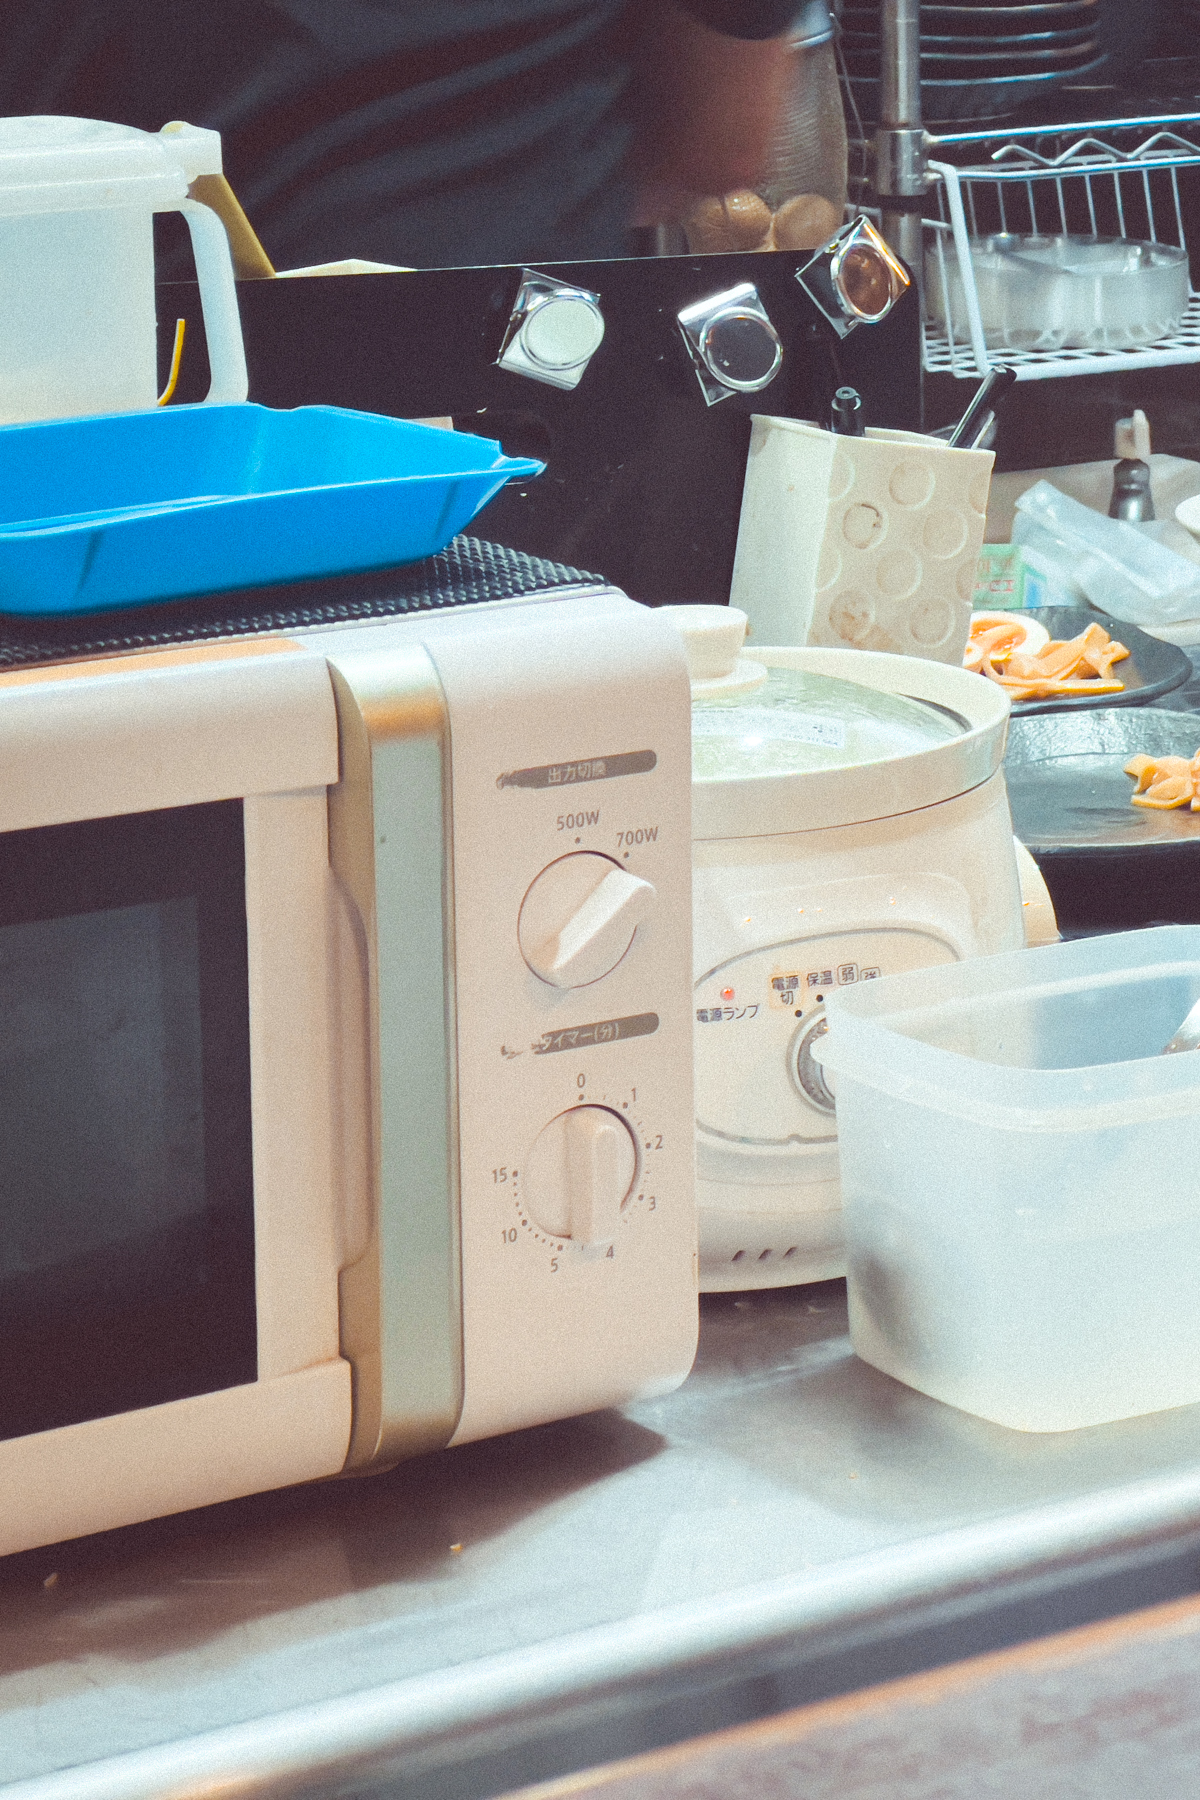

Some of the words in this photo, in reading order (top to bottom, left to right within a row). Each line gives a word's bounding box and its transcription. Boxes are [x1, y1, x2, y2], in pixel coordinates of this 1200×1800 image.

[548, 759, 607, 784] 出力切換
[556, 809, 601, 831] 500W
[616, 826, 660, 848] 700W
[771, 974, 799, 991] 電源
[806, 970, 834, 987] 保温
[841, 966, 855, 982] 弱
[780, 990, 794, 1005] 切
[696, 1003, 760, 1023] 電源ランプ
[576, 1073, 586, 1089] 0
[631, 1087, 637, 1102] 1
[655, 1135, 664, 1150] 2
[492, 1167, 508, 1184] 15
[648, 1196, 657, 1212] 3
[501, 1227, 518, 1244] 10
[605, 1245, 614, 1259] 4
[550, 1258, 559, 1273] 5
